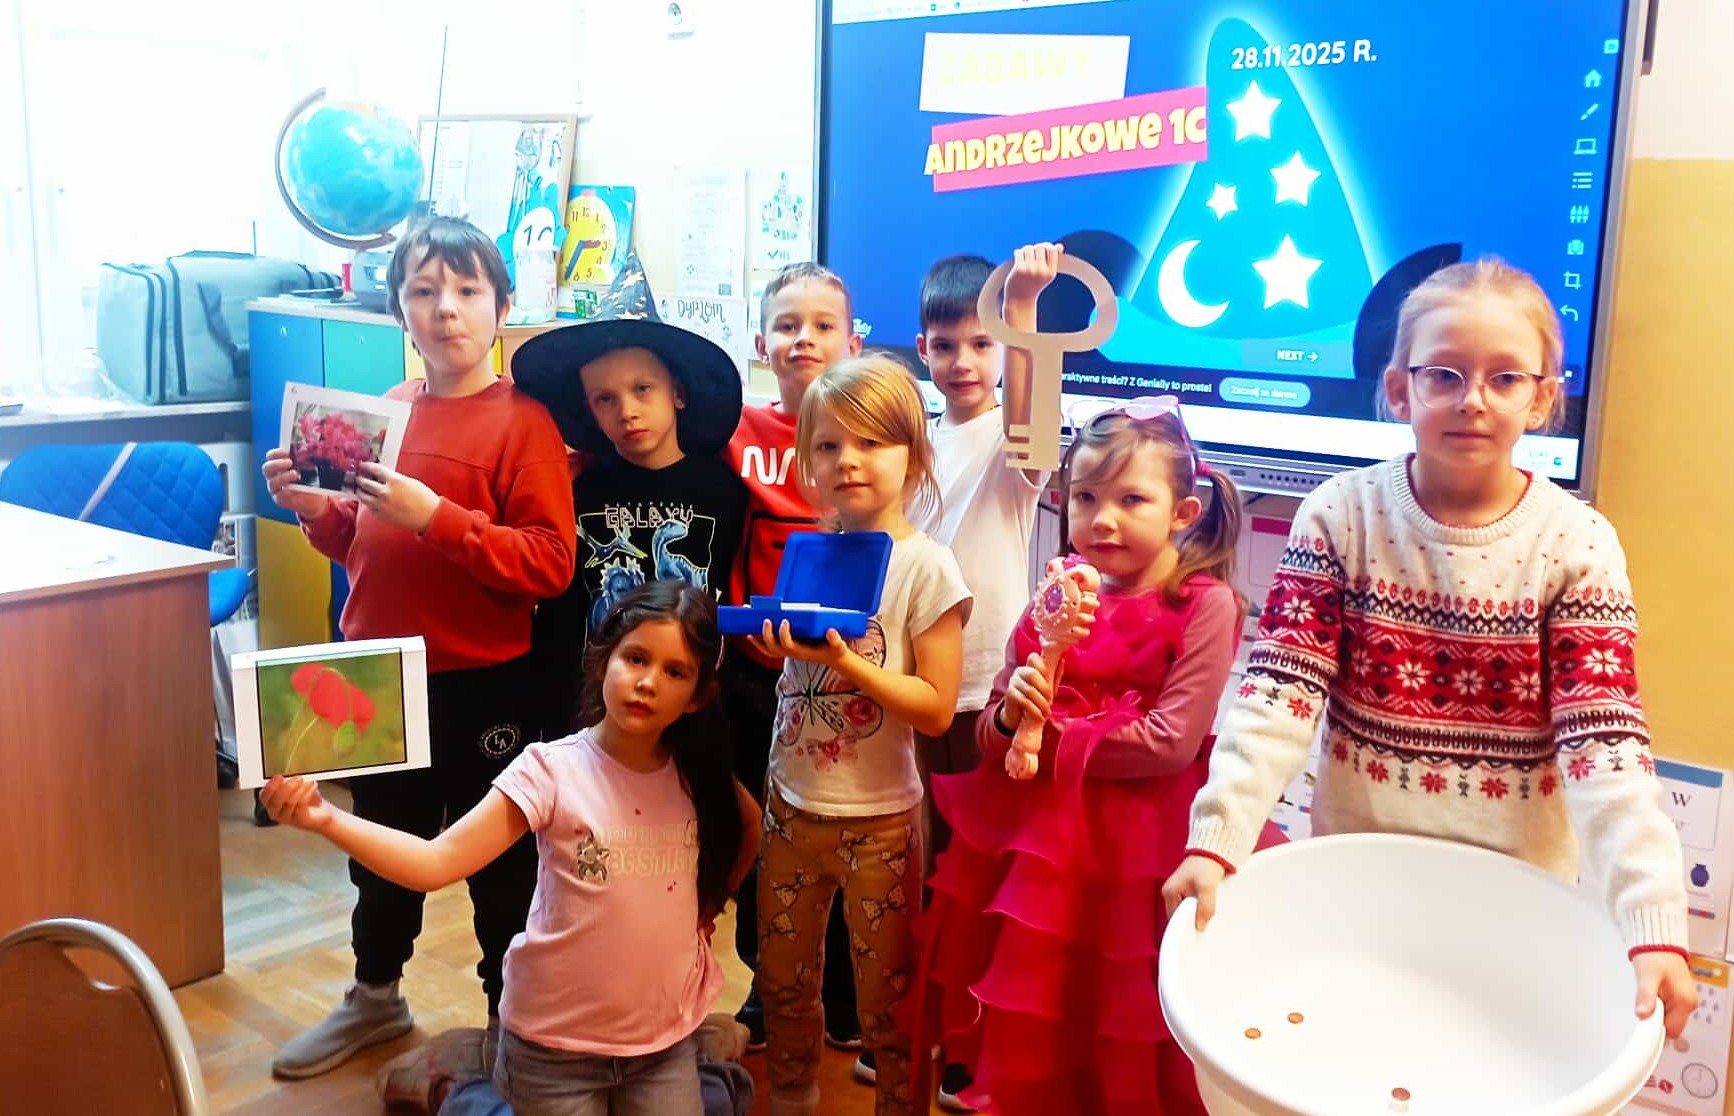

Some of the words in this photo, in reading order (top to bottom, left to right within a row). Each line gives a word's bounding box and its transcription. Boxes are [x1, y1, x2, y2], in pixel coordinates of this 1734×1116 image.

[940, 45, 1093, 84] ZABAWY
[1231, 40, 1346, 70] 28.11.2025
[1353, 39, 1377, 63] R.
[1168, 106, 1207, 145] 1C
[1276, 349, 1305, 361] NEXT
[1171, 380, 1181, 390] to
